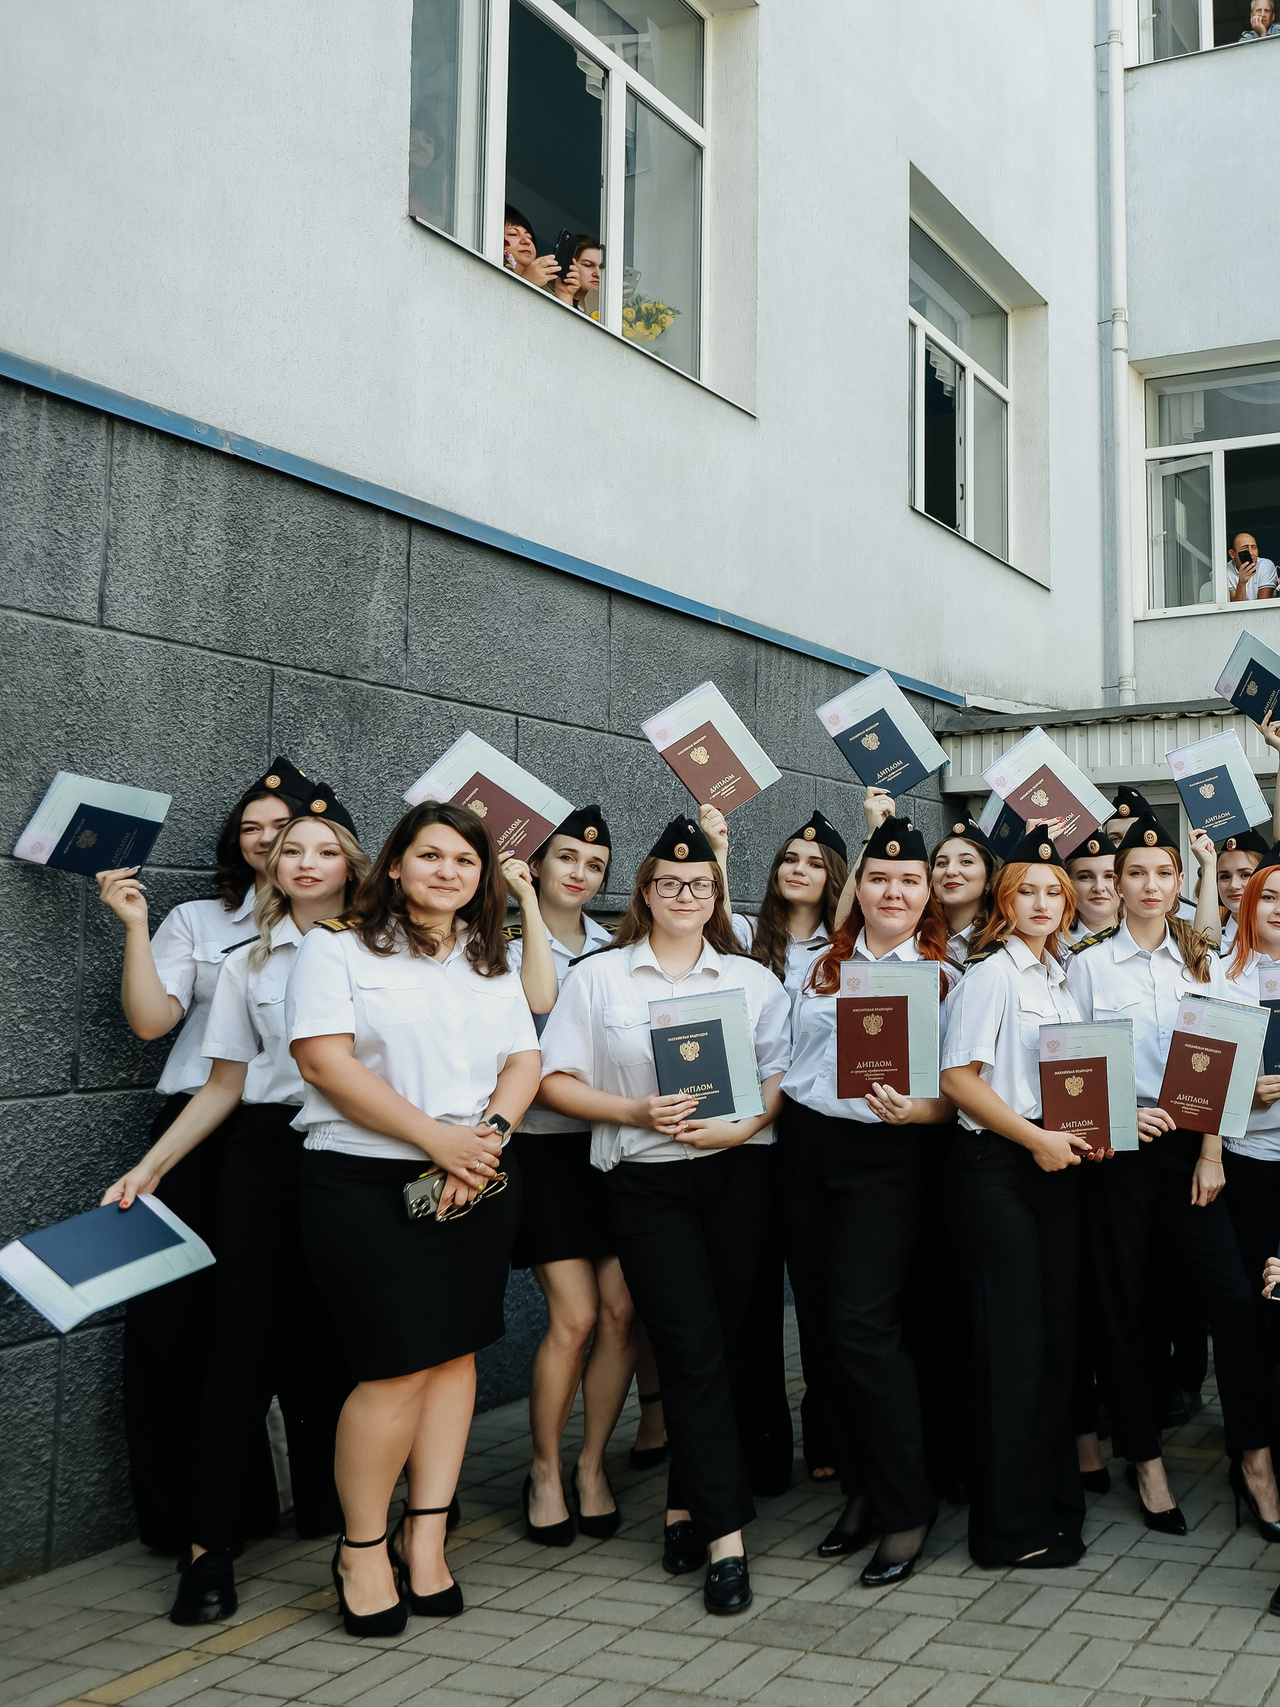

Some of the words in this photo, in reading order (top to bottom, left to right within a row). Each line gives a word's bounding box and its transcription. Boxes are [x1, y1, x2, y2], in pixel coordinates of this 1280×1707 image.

[876, 760, 903, 779] ДИПЛОМ
[709, 773, 735, 794] ДИПЛОМ
[1205, 811, 1231, 824] ДИПЛОМ
[496, 818, 522, 846] ДИПЛОМ
[856, 1060, 892, 1069] ДИПЛОМ
[679, 1083, 713, 1095] ДИПЛОМ
[1176, 1093, 1209, 1105] ДИПЛОМ
[1060, 1119, 1094, 1130] ДИПЛОМ
